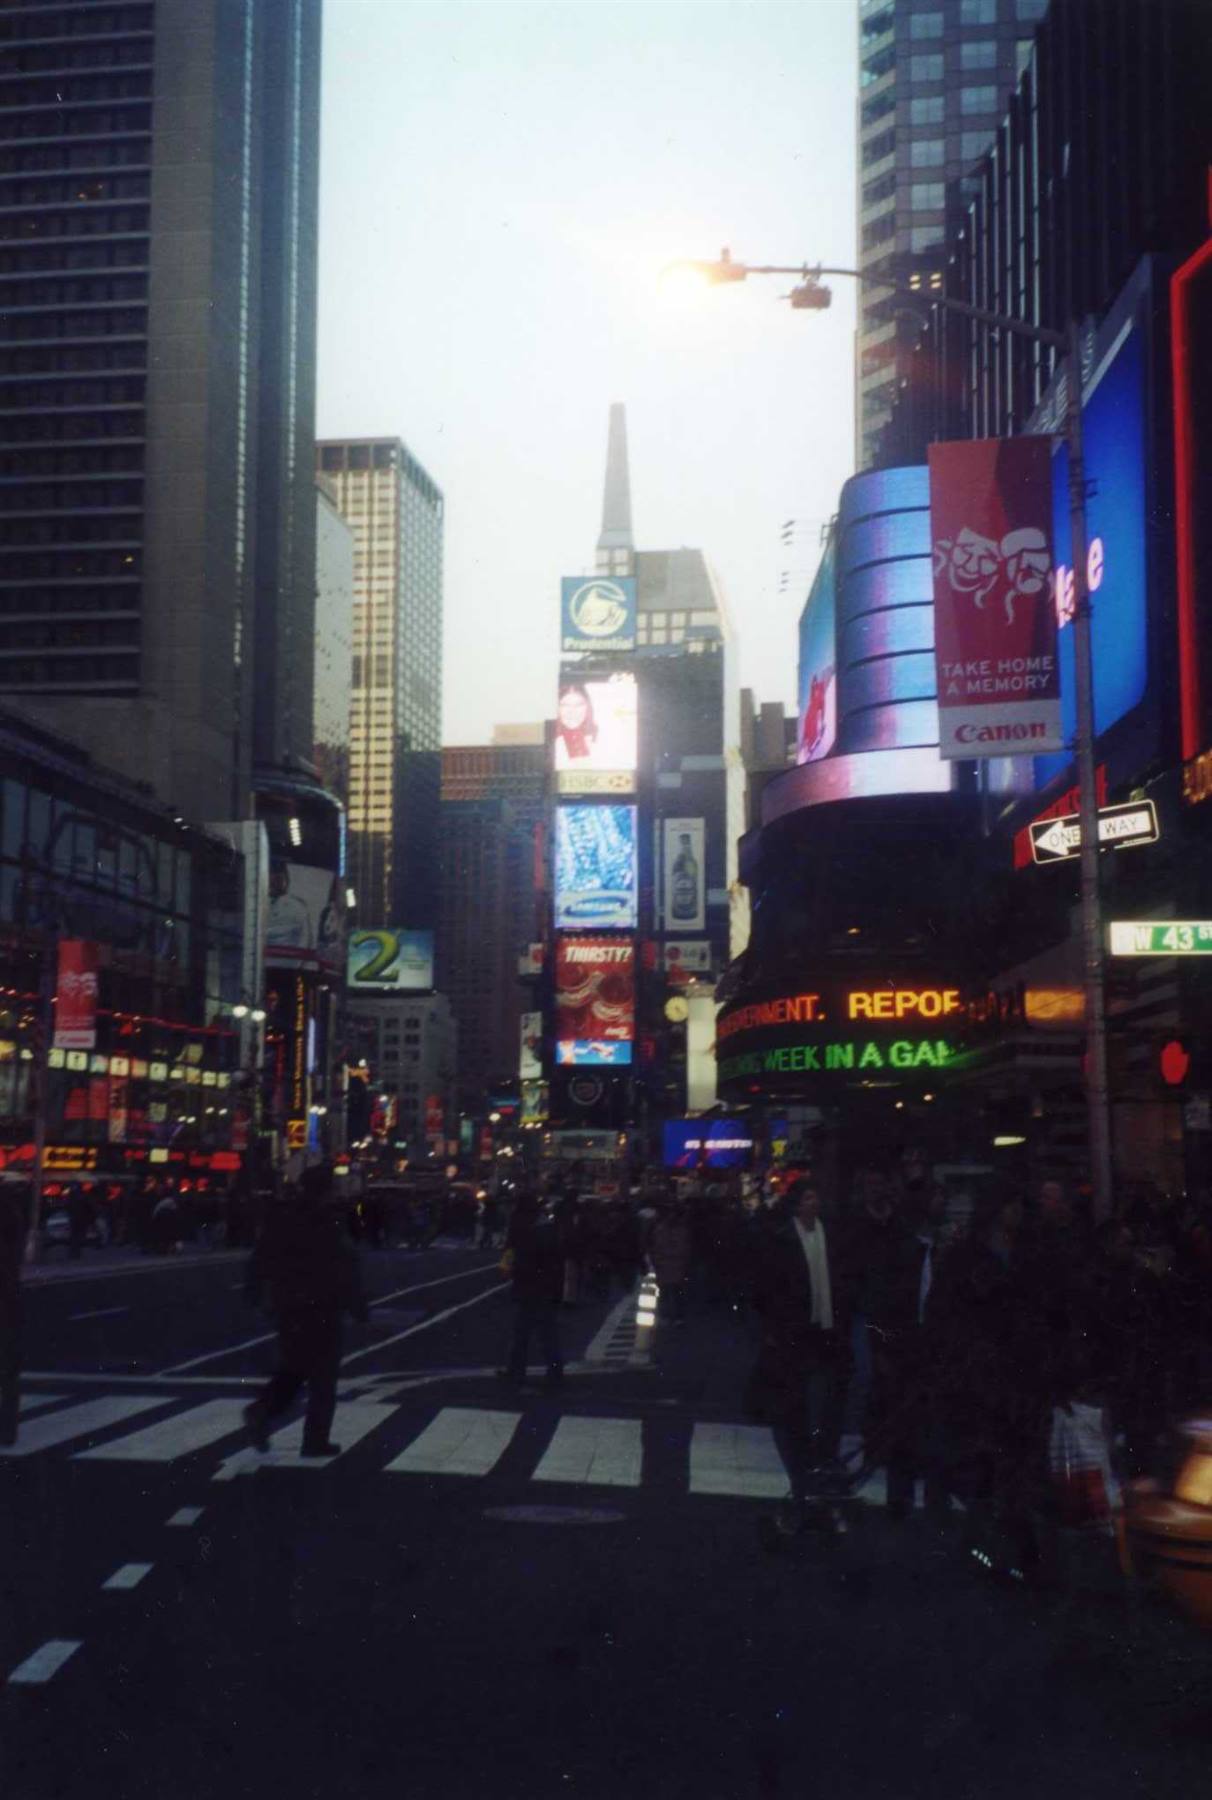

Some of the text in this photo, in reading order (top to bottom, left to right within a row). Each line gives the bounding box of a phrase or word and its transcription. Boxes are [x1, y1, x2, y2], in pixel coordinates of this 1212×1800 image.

[942, 656, 1054, 678] TAKE HOME
[945, 674, 1050, 696] A MEMORY
[954, 721, 1047, 744] Canon
[1049, 817, 1140, 848] ONE WAY
[1162, 926, 1194, 950] 43
[352, 929, 400, 982] 2
[565, 946, 633, 963] THIRSTY?
[764, 1046, 821, 1072] WEEK
[825, 1043, 854, 1069] IN
[858, 1042, 883, 1069] A
